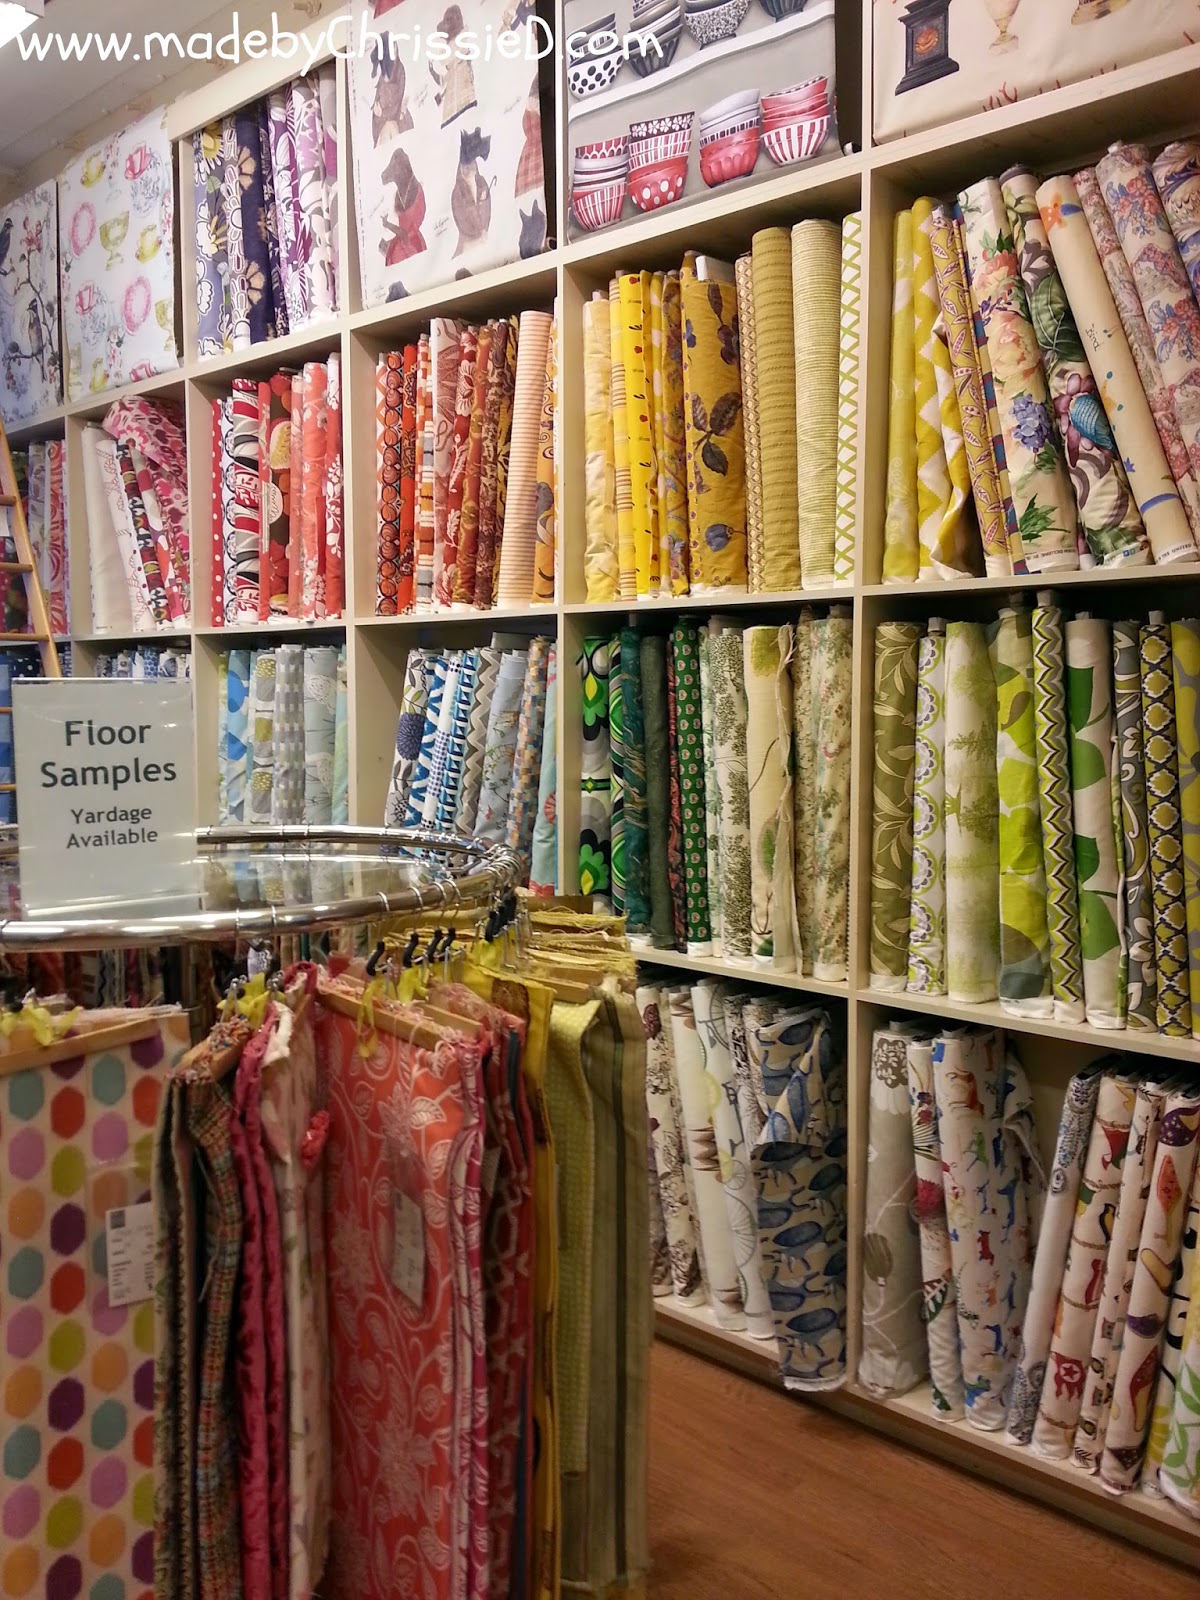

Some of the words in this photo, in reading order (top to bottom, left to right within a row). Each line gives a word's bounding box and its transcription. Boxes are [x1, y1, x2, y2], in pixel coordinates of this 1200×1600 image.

[65, 720, 152, 746] Floor
[40, 757, 177, 791] Samples
[71, 806, 152, 824] Yardage
[66, 828, 158, 849] Available
